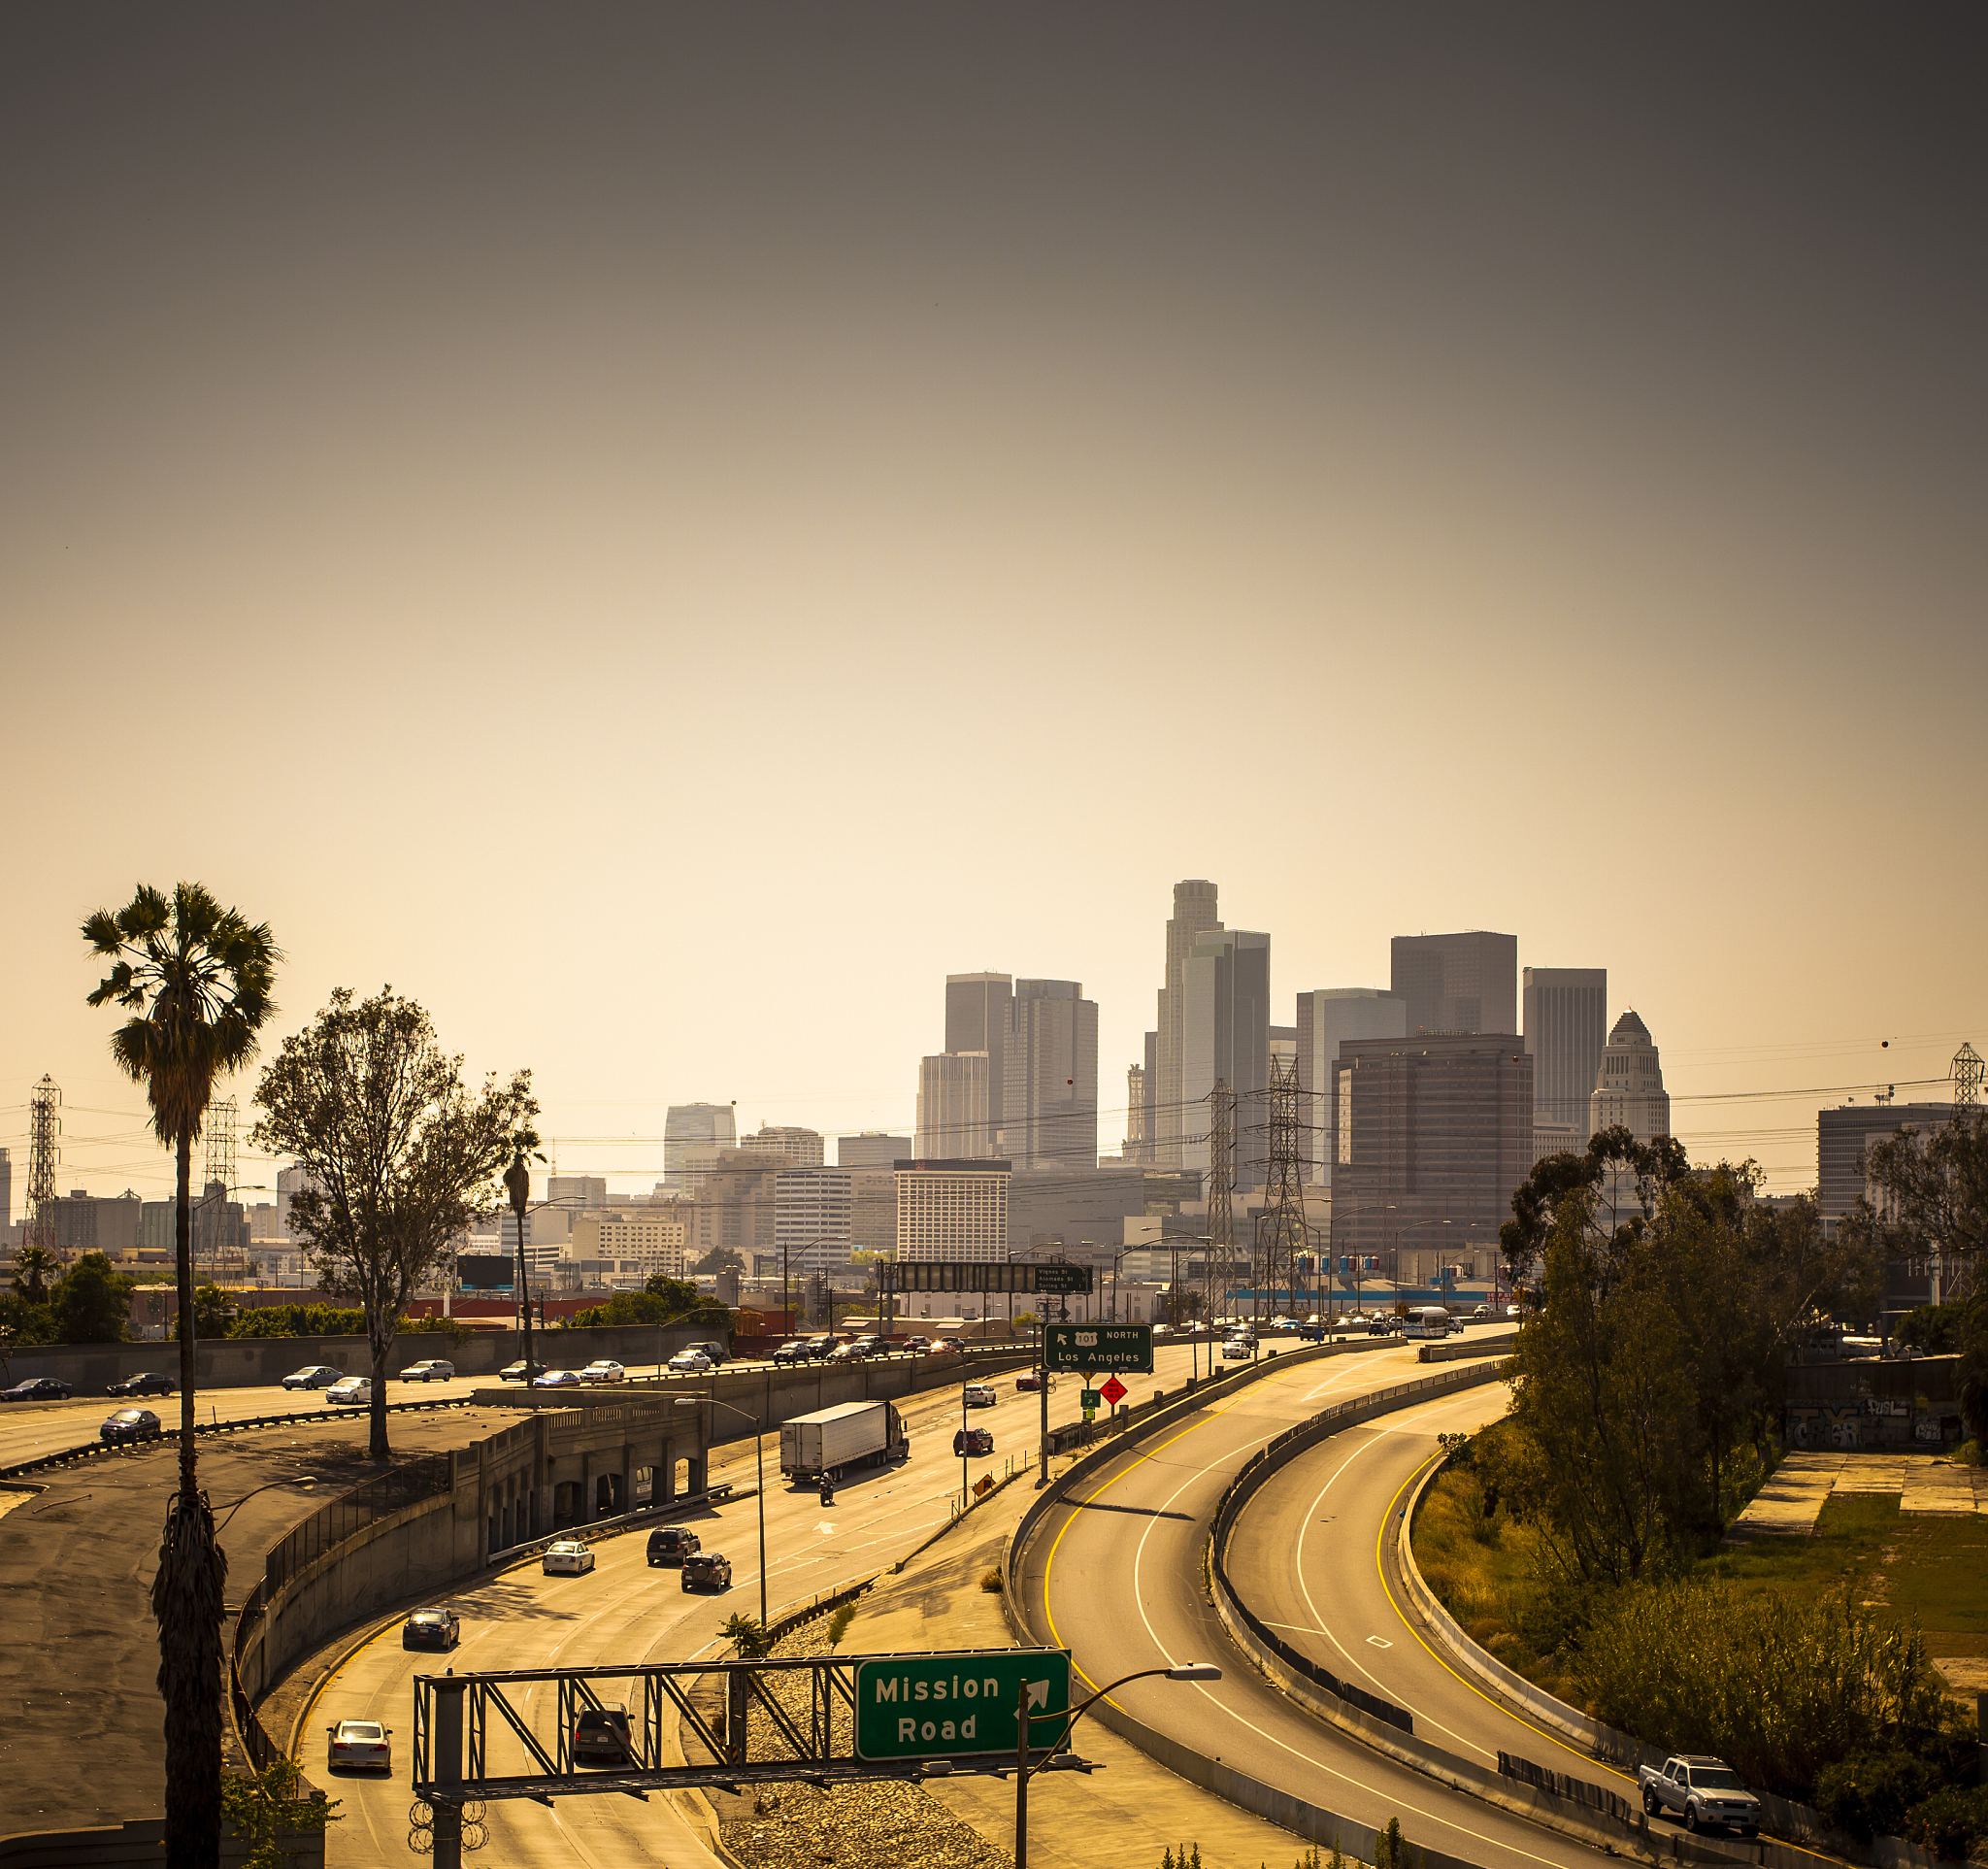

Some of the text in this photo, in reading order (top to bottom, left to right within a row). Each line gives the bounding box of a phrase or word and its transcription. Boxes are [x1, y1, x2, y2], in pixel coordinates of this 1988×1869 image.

[1058, 1352, 1139, 1365] Los Angeles
[876, 1675, 999, 1703] Mission
[898, 1714, 976, 1743] Road
